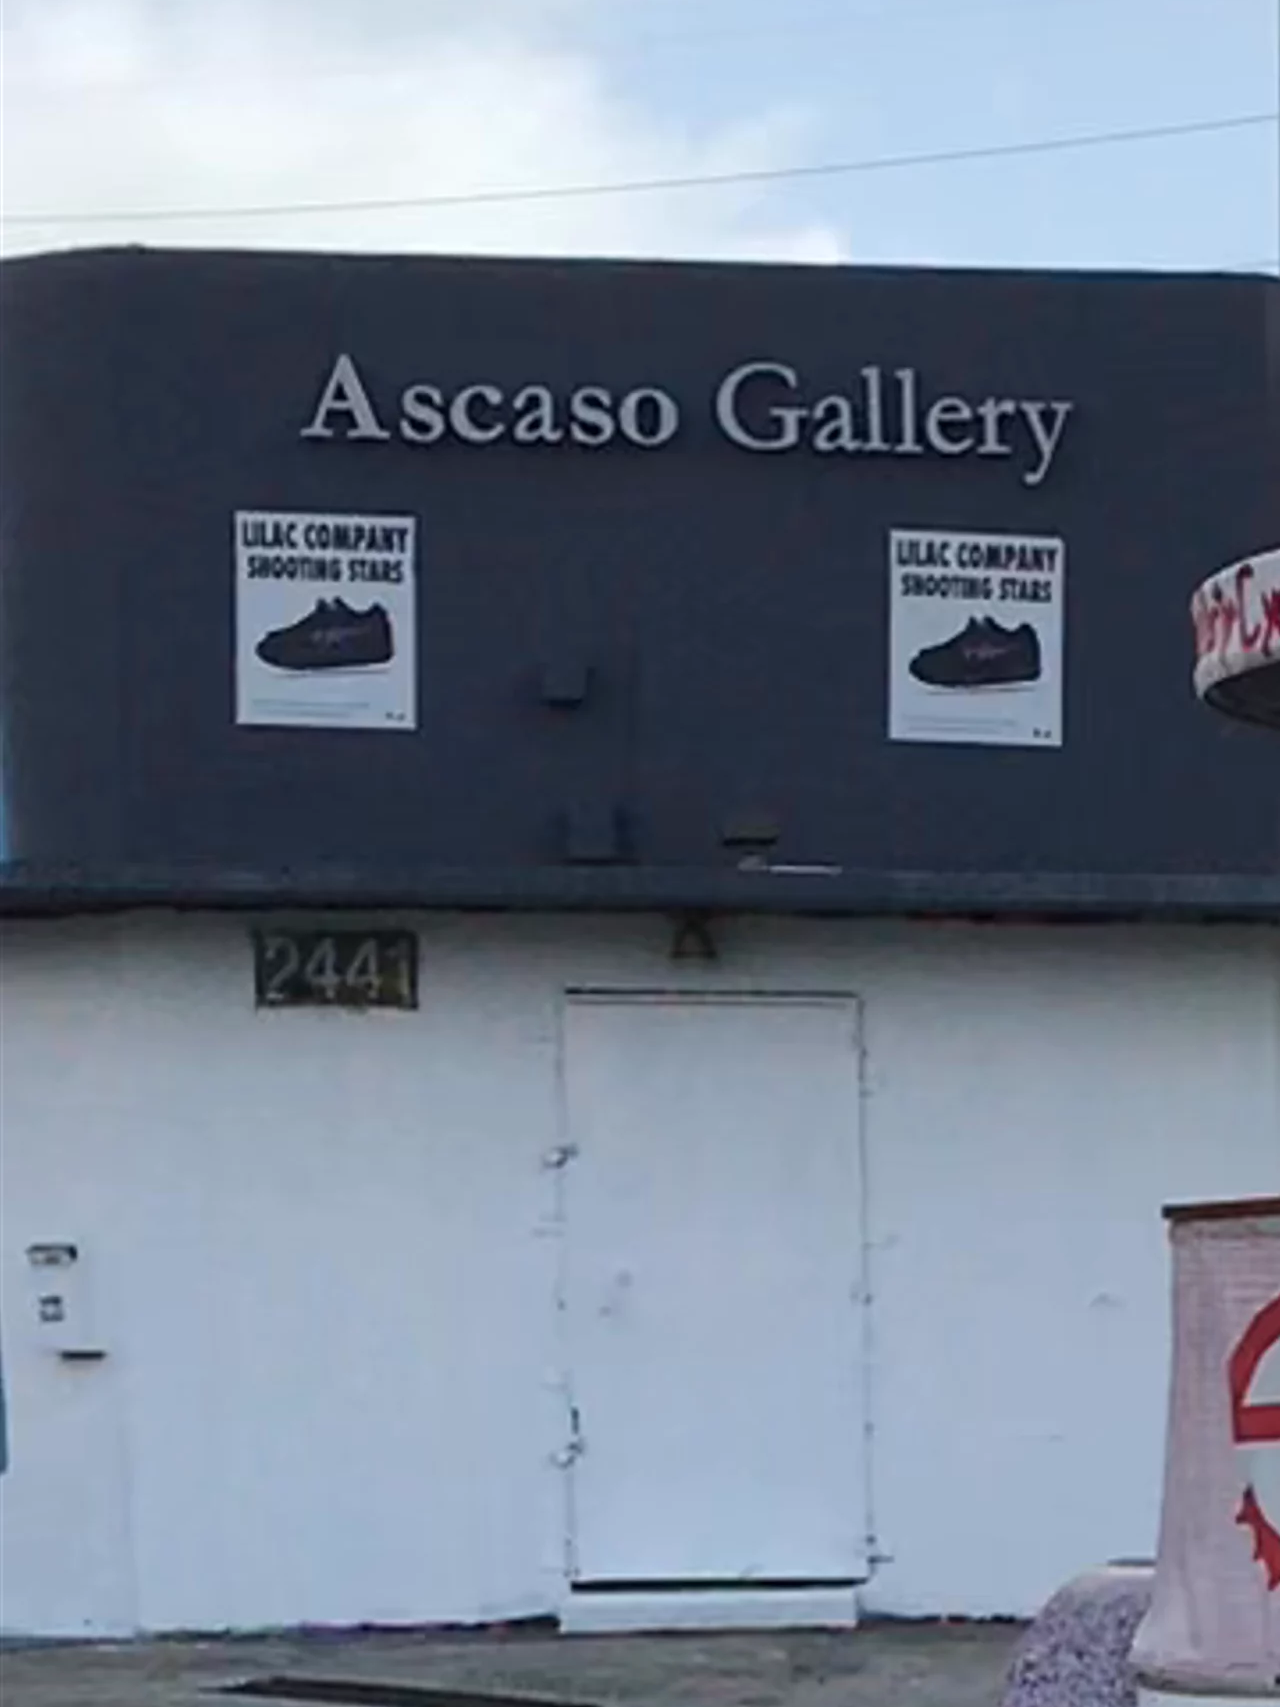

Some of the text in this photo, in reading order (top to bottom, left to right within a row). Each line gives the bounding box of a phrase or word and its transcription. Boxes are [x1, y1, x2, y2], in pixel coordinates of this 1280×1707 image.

[301, 354, 1074, 484] Ascaso Gallery
[242, 521, 408, 553] LILAC COMPANY
[247, 555, 404, 584] SHOOTING STARS
[897, 539, 1058, 572] LILAC COMPANY
[902, 573, 1052, 603] SHOOTING STARS
[265, 936, 413, 1000] 2441
